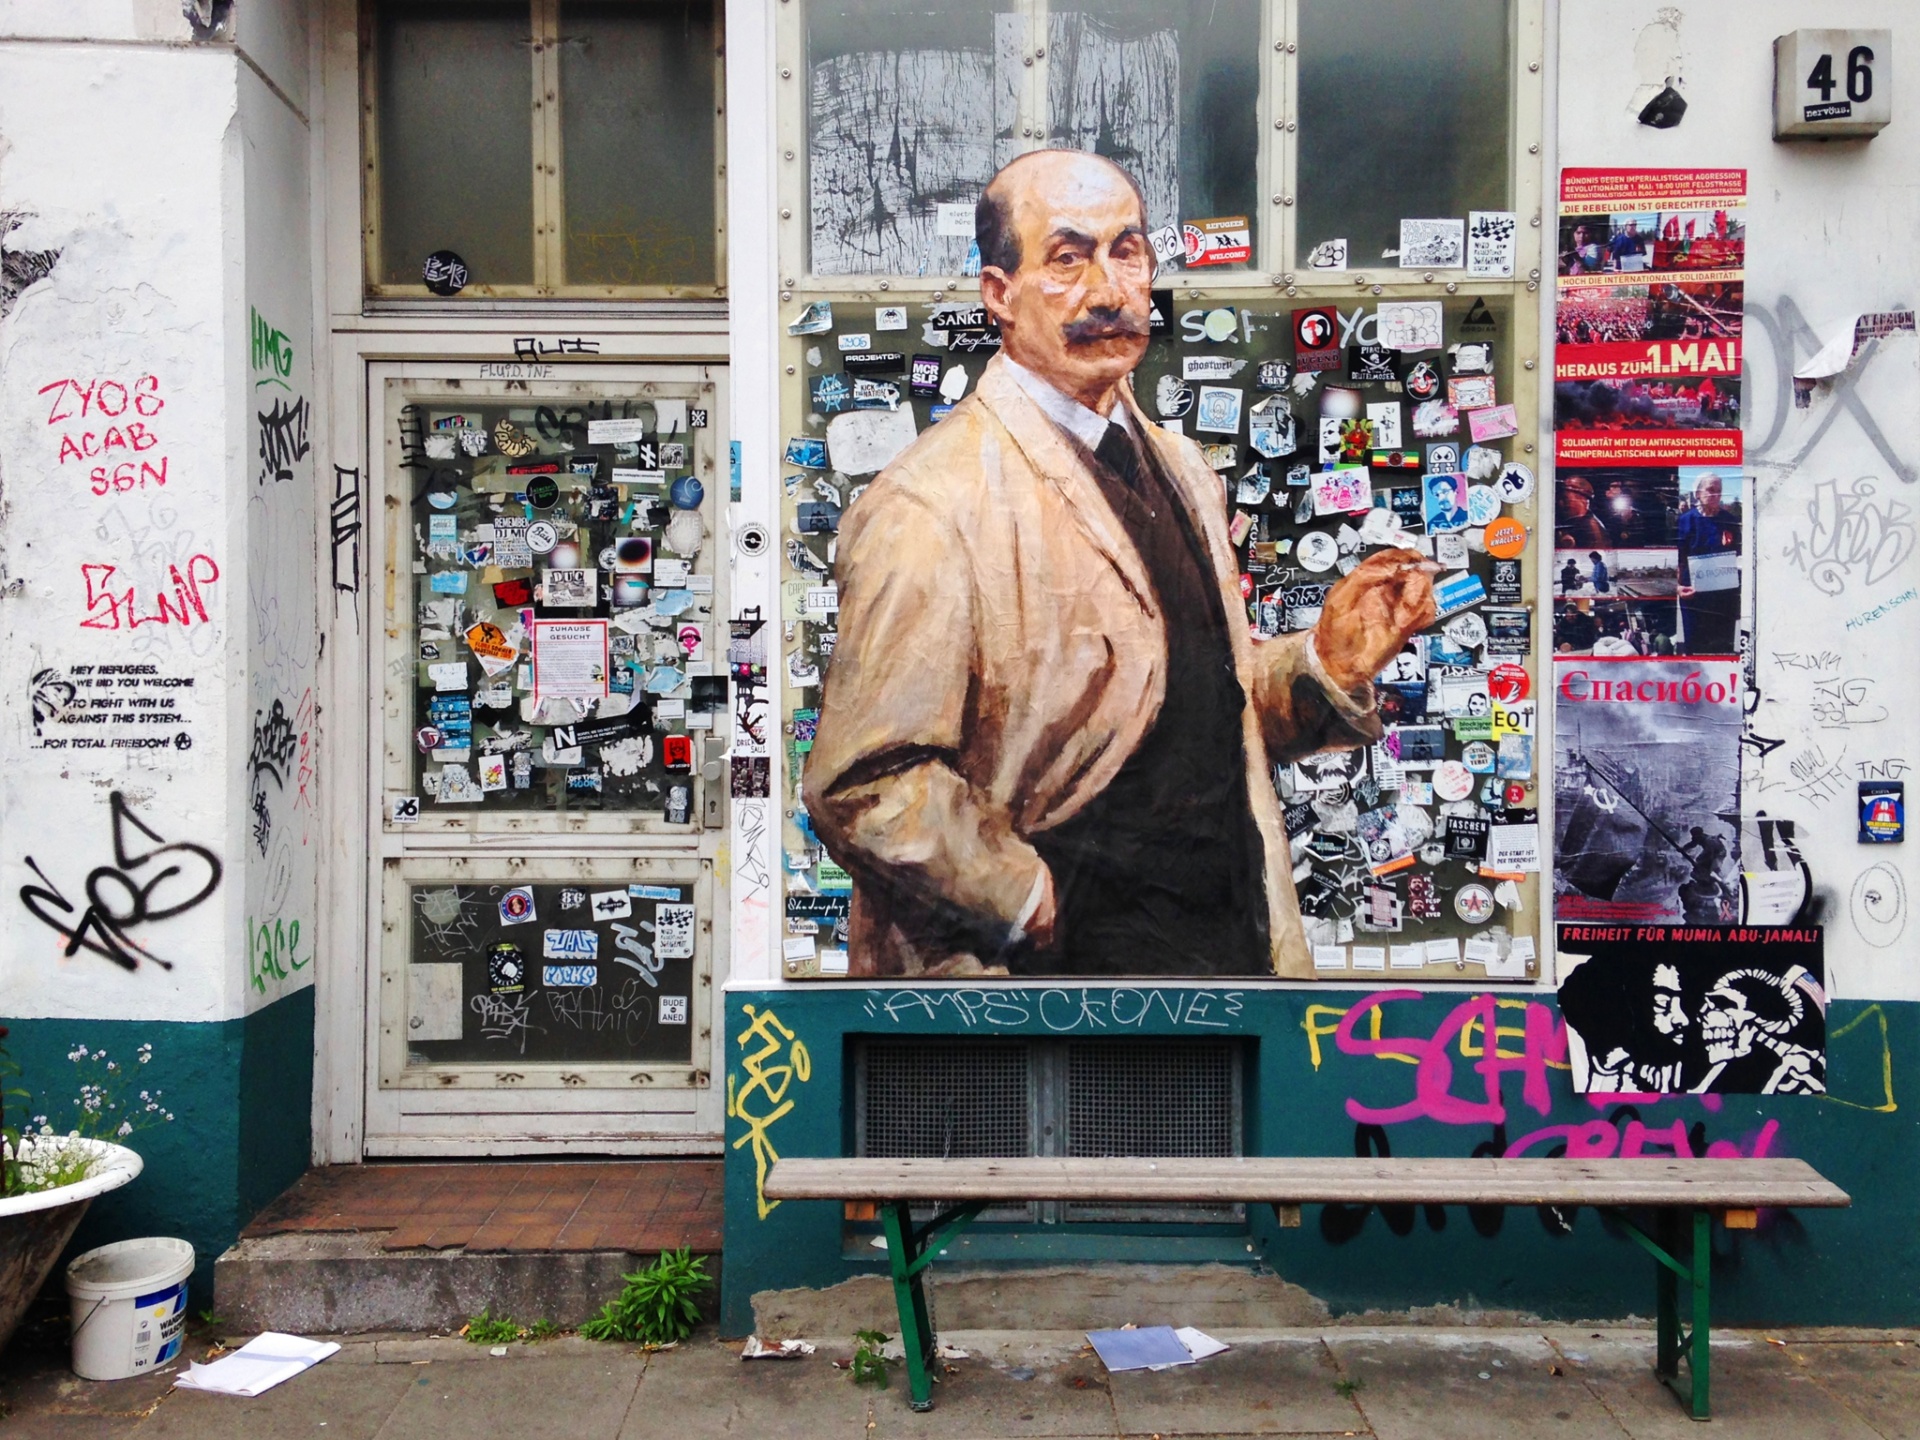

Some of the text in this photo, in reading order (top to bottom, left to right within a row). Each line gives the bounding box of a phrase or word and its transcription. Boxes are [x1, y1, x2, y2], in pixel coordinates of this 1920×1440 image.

[1807, 46, 1875, 103] 46
[1565, 175, 1600, 185] BÜNDNIS
[1626, 173, 1694, 183] IMPERIALISTISCHE
[1695, 172, 1741, 181] AGGRESSION
[1565, 183, 1629, 193] REVOLUTIONÄRER
[1675, 181, 1690, 189] UHR
[1691, 180, 1742, 189] FELDSTRASSE
[1564, 190, 1637, 199] INTERNATIONALISTISCHER
[1564, 204, 1580, 213] DIE
[1582, 202, 1636, 212] REBELLION
[1655, 199, 1738, 210] GERECHTFERTIGT
[1208, 250, 1246, 261] WELCOME
[1563, 271, 1737, 285] HOCH DIE INTERNATIONALE SOLIDARITÄT!
[937, 313, 984, 326] SANKT
[845, 352, 900, 362] PROJEKTOR
[913, 364, 939, 375] MCR
[1556, 362, 1617, 377] HERAUS
[1621, 360, 1652, 374] ZUM
[911, 373, 939, 385] SLP
[1562, 437, 1736, 448] SOLIDARITÄT MIT DEM ANTIFASCHISTISCHEN,
[1559, 449, 1738, 459] ANTIIMPERIALISTISCHEN KAMPF IM DONBASS!
[70, 664, 159, 676] HEY REFUGEES,
[76, 679, 93, 688] WE
[117, 678, 139, 687] YOU
[143, 677, 194, 688] WELCOME
[1560, 669, 1738, 705] Спасибо!
[72, 698, 175, 709] TO FIGHT WITH US
[58, 713, 109, 723] AGAINST
[112, 713, 135, 723] THIS
[1494, 710, 1535, 733] EQT
[71, 738, 107, 749] TOTAL
[111, 737, 170, 749] FREEDOM!
[1448, 818, 1487, 832] TASCHEN
[1563, 927, 1819, 943] FREIHEIT FÜR MUMIA ABU-JAMAL!
[662, 999, 684, 1007] BUDE
[662, 1014, 684, 1022] ANED
